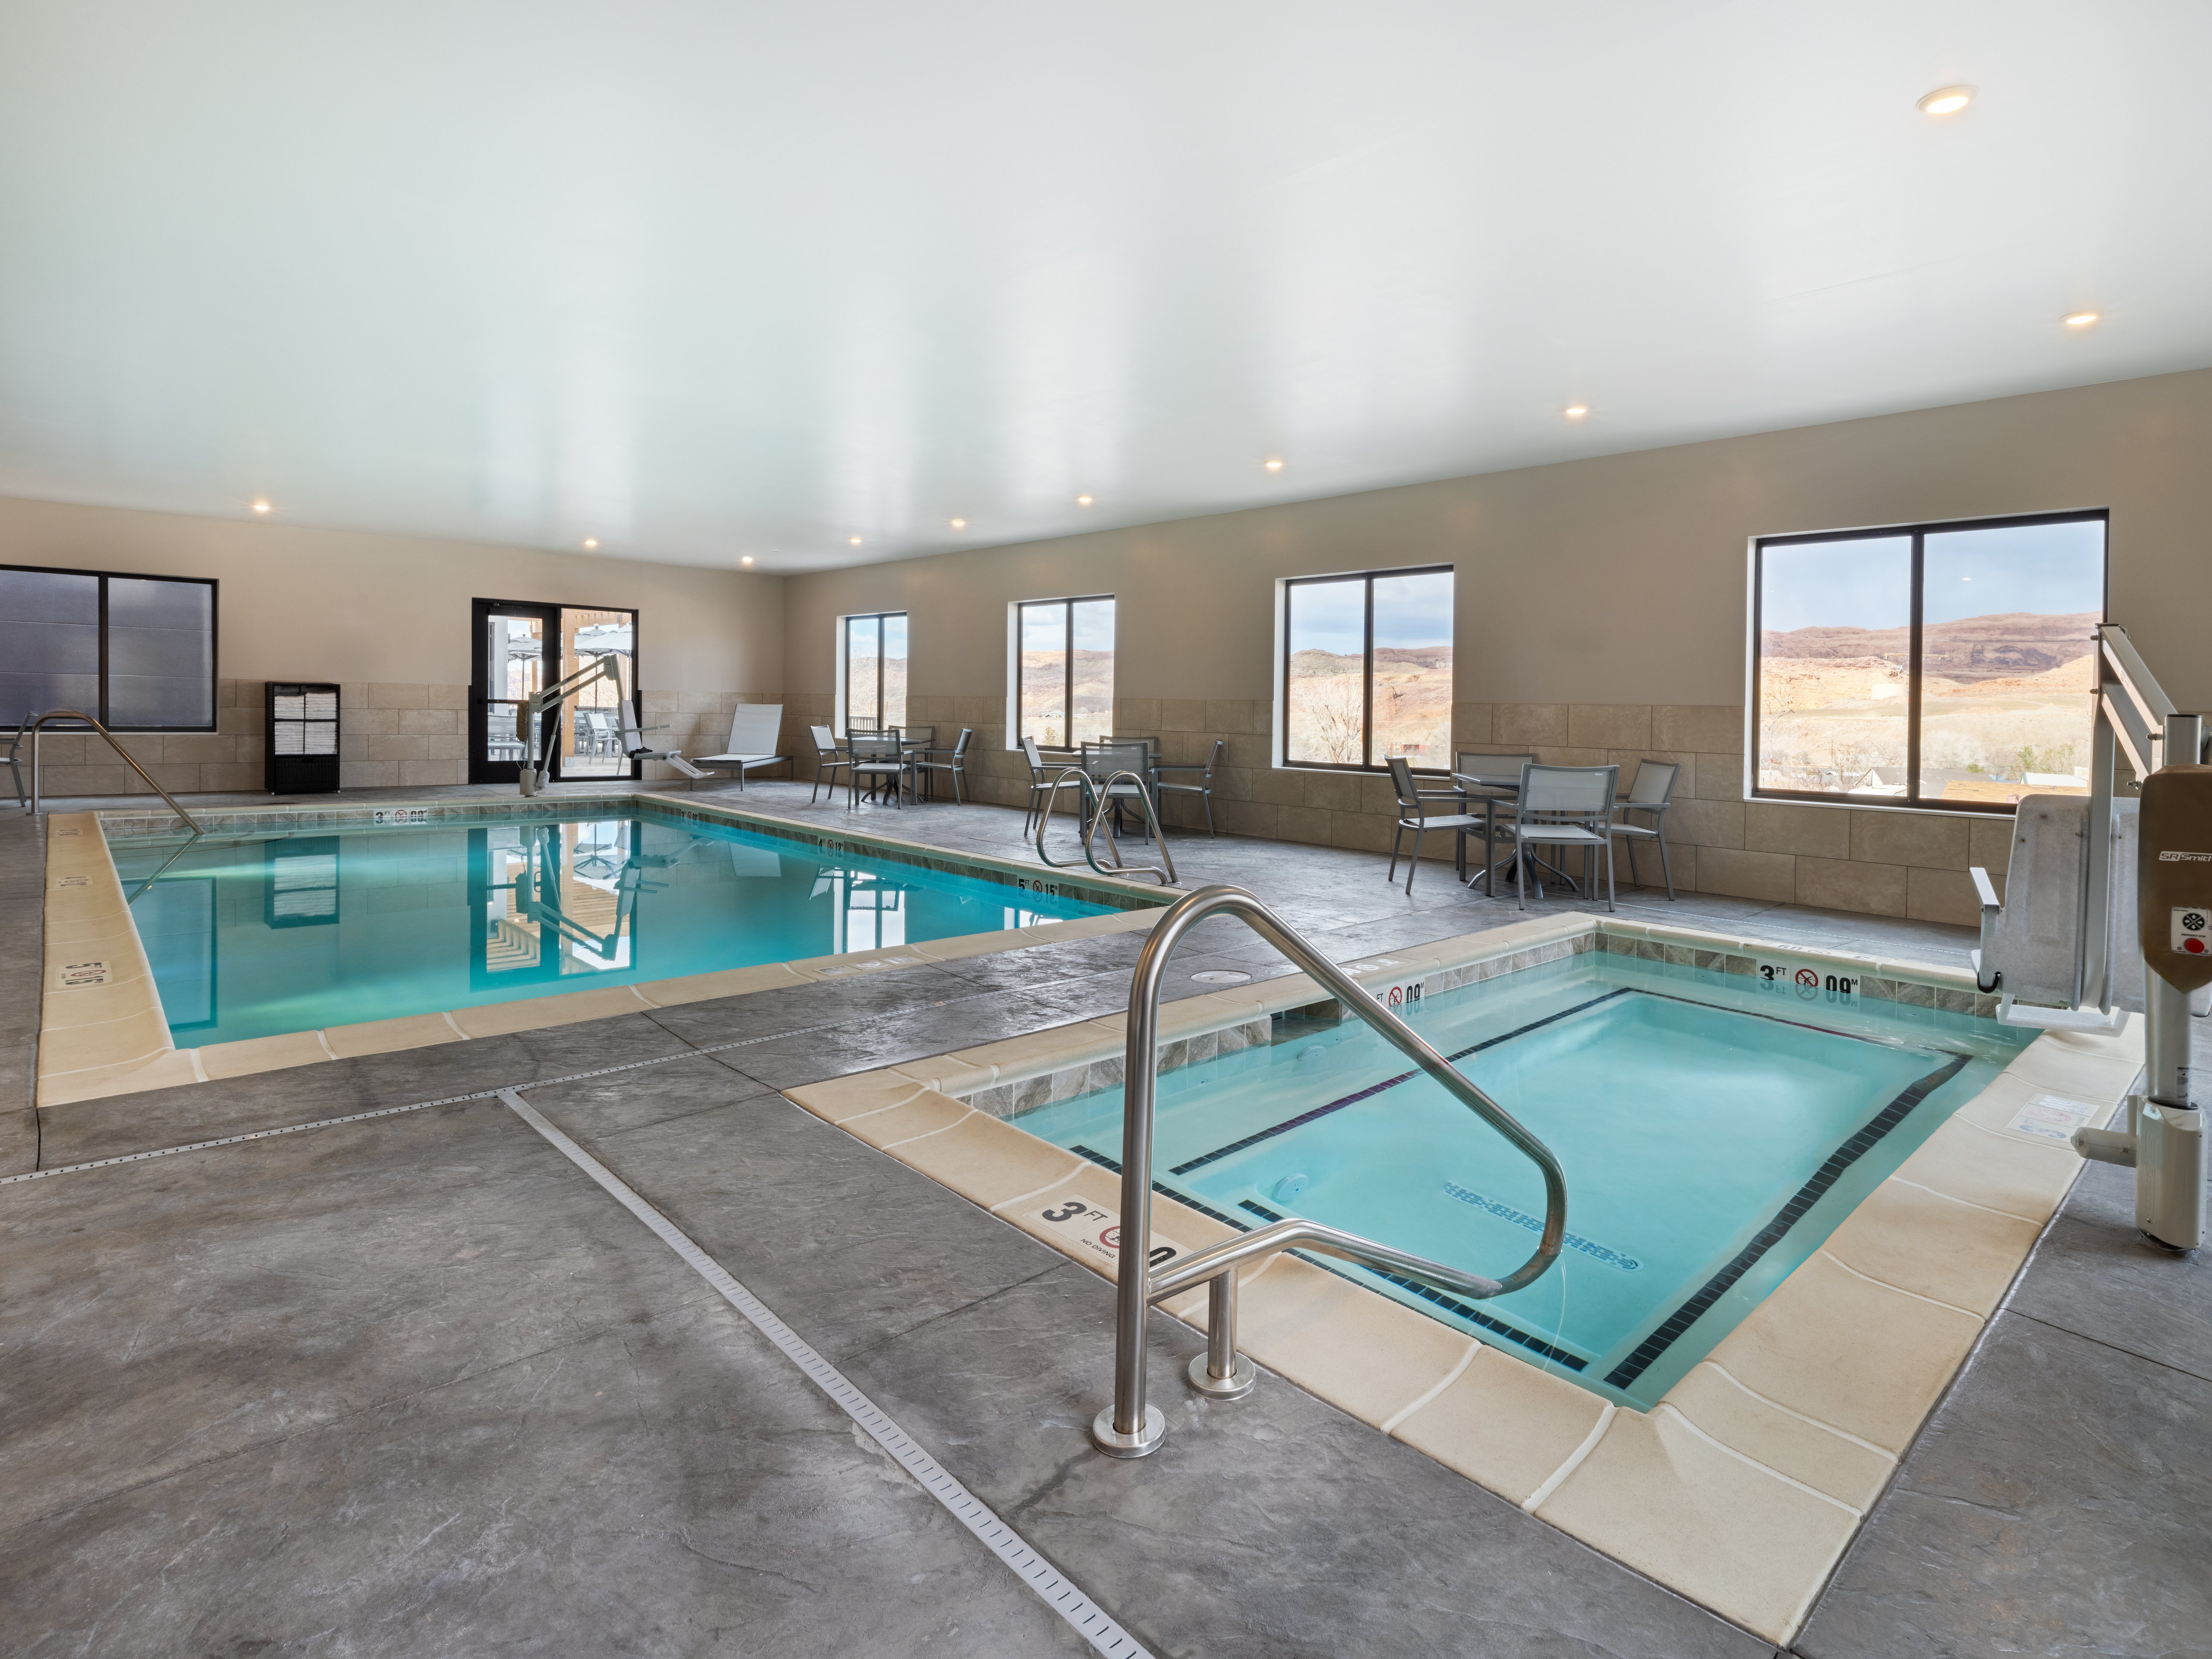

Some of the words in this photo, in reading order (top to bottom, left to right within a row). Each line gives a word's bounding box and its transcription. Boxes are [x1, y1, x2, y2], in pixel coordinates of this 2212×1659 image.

[1019, 878, 1025, 890] 5
[1760, 965, 1775, 980] 3
[1776, 966, 1787, 976] FT
[1042, 1201, 1087, 1222] 3
[1084, 1210, 1109, 1221] FT
[1091, 1245, 1116, 1259] DIVING
